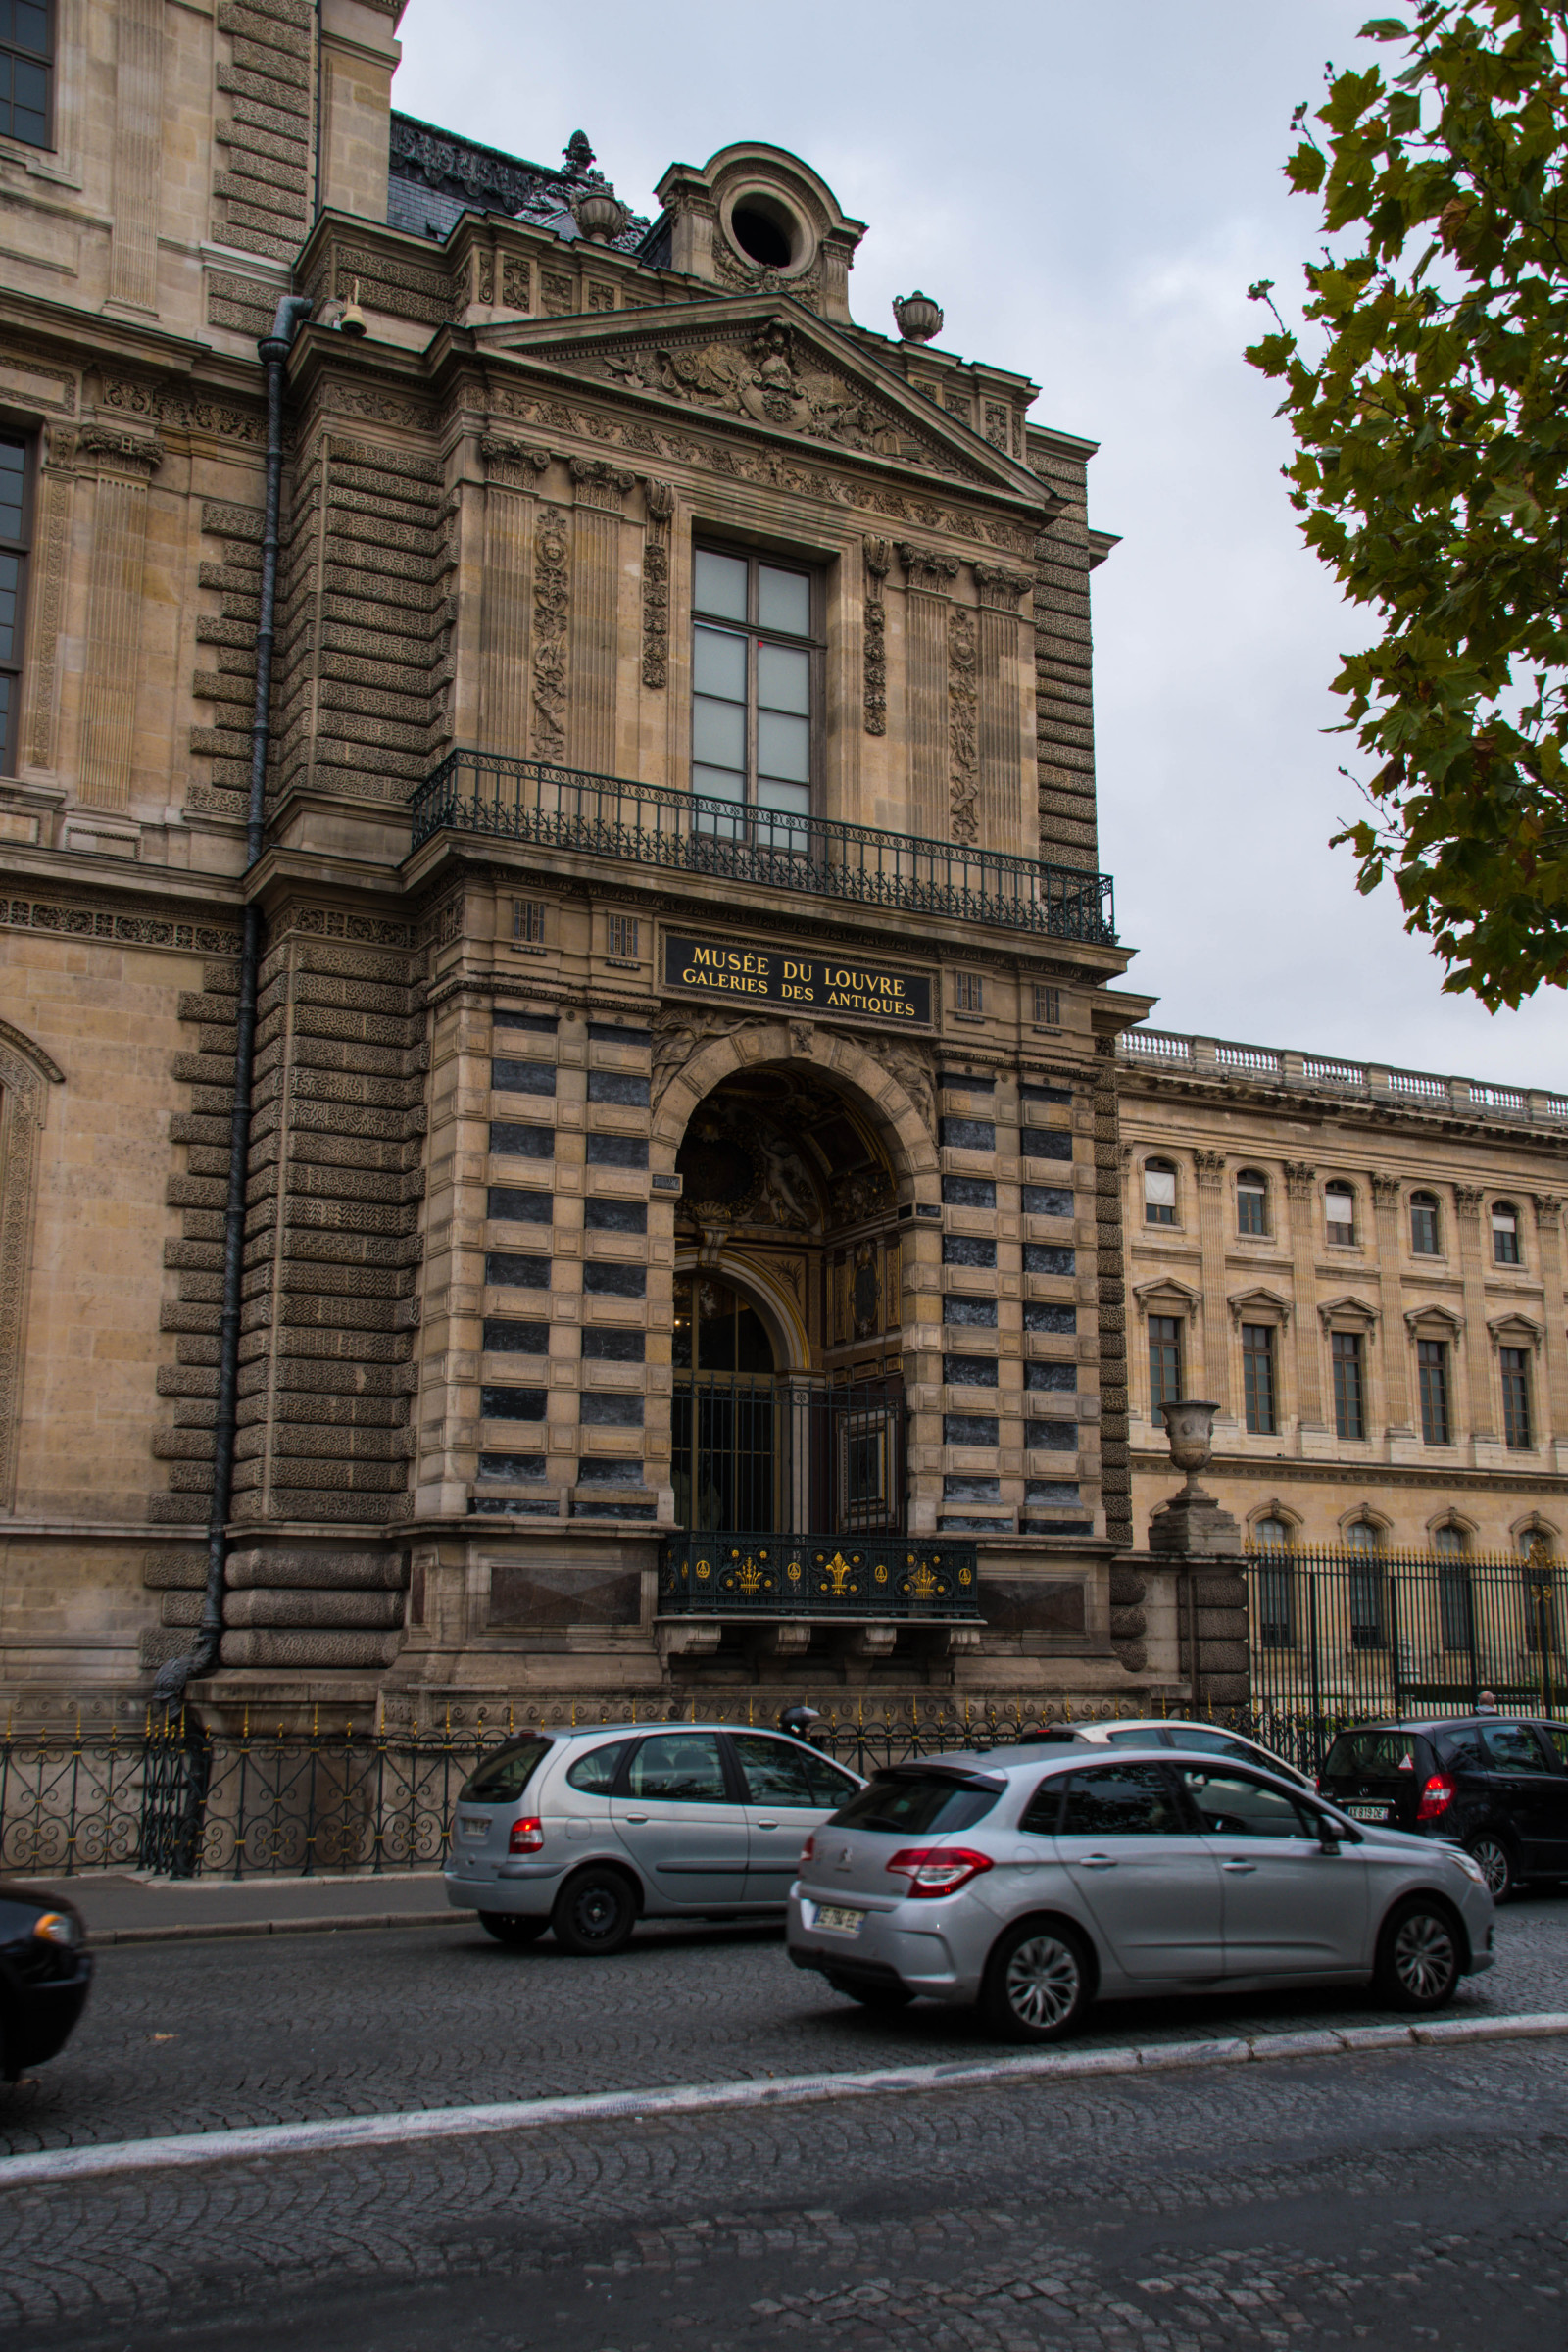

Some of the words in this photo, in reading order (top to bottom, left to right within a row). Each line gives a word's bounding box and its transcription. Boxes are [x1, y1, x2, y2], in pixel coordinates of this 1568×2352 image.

[682, 968, 768, 994] GALERIES
[781, 983, 814, 1001] DES
[826, 991, 915, 1016] ANTIQUES
[692, 947, 769, 975] MUSÉE
[783, 961, 813, 982] DU
[824, 968, 906, 997] LOUVRE
